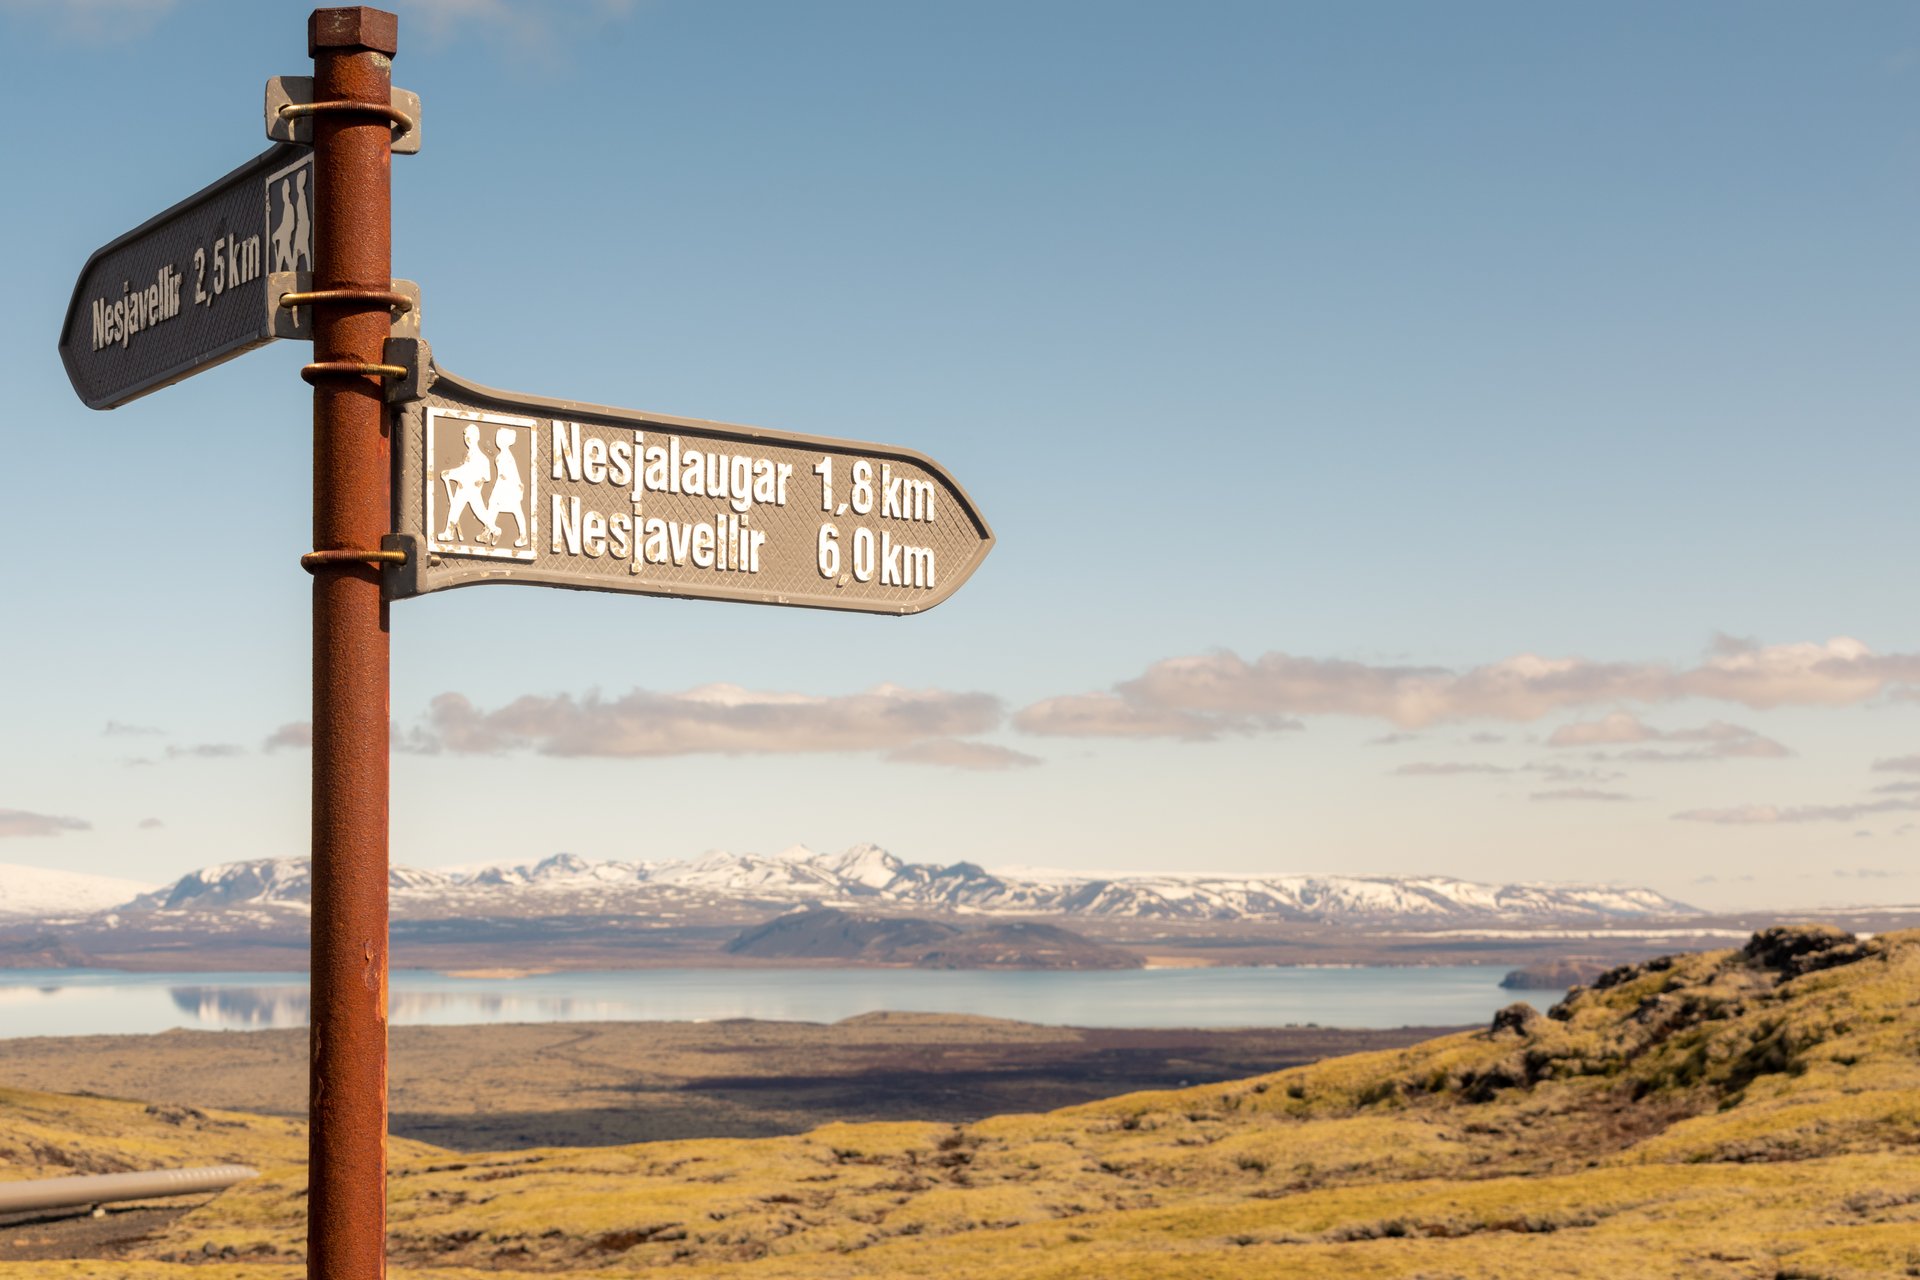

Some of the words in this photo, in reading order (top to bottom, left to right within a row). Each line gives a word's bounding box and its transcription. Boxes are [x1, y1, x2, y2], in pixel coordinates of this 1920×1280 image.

[92, 263, 182, 352] Nesjavellir
[551, 419, 793, 512] Nesjalaugar
[551, 495, 766, 574] Nesjavellir
